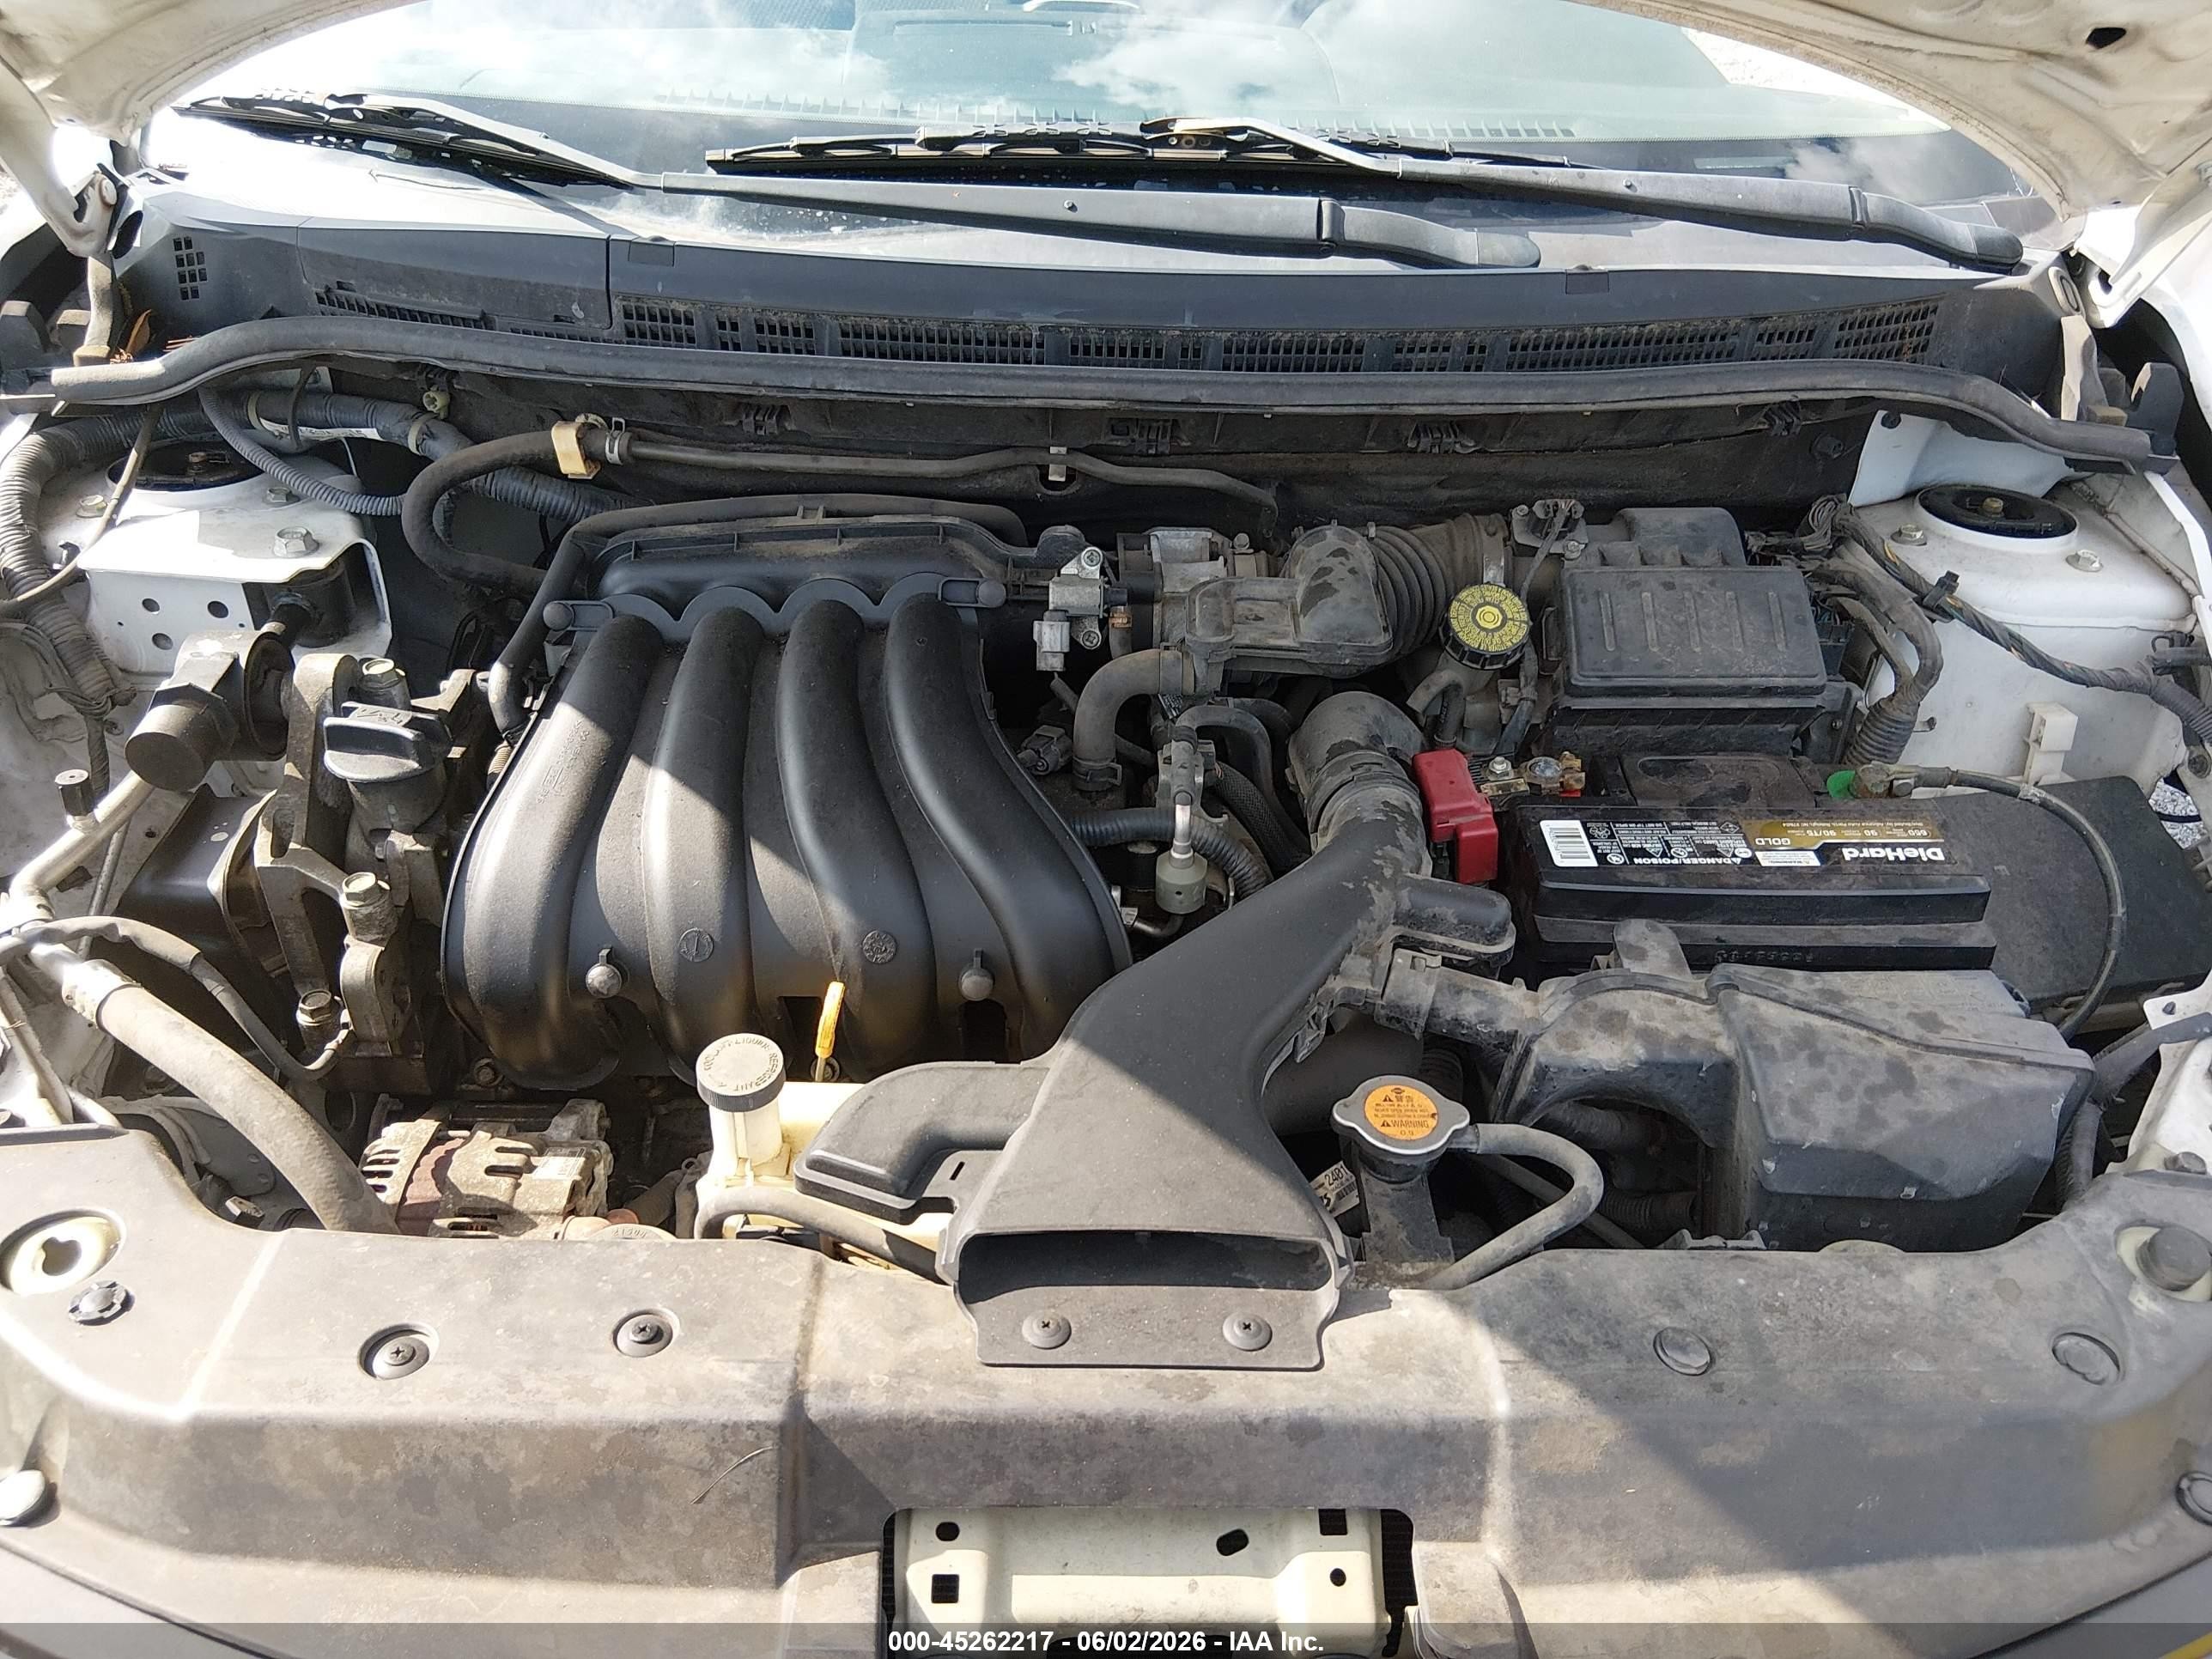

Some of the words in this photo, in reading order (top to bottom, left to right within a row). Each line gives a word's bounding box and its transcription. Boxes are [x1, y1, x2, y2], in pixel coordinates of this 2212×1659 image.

[1755, 837, 1791, 846] GOLD
[1843, 847, 1945, 861] DieHard
[1391, 1119, 1429, 1128] WARNING
